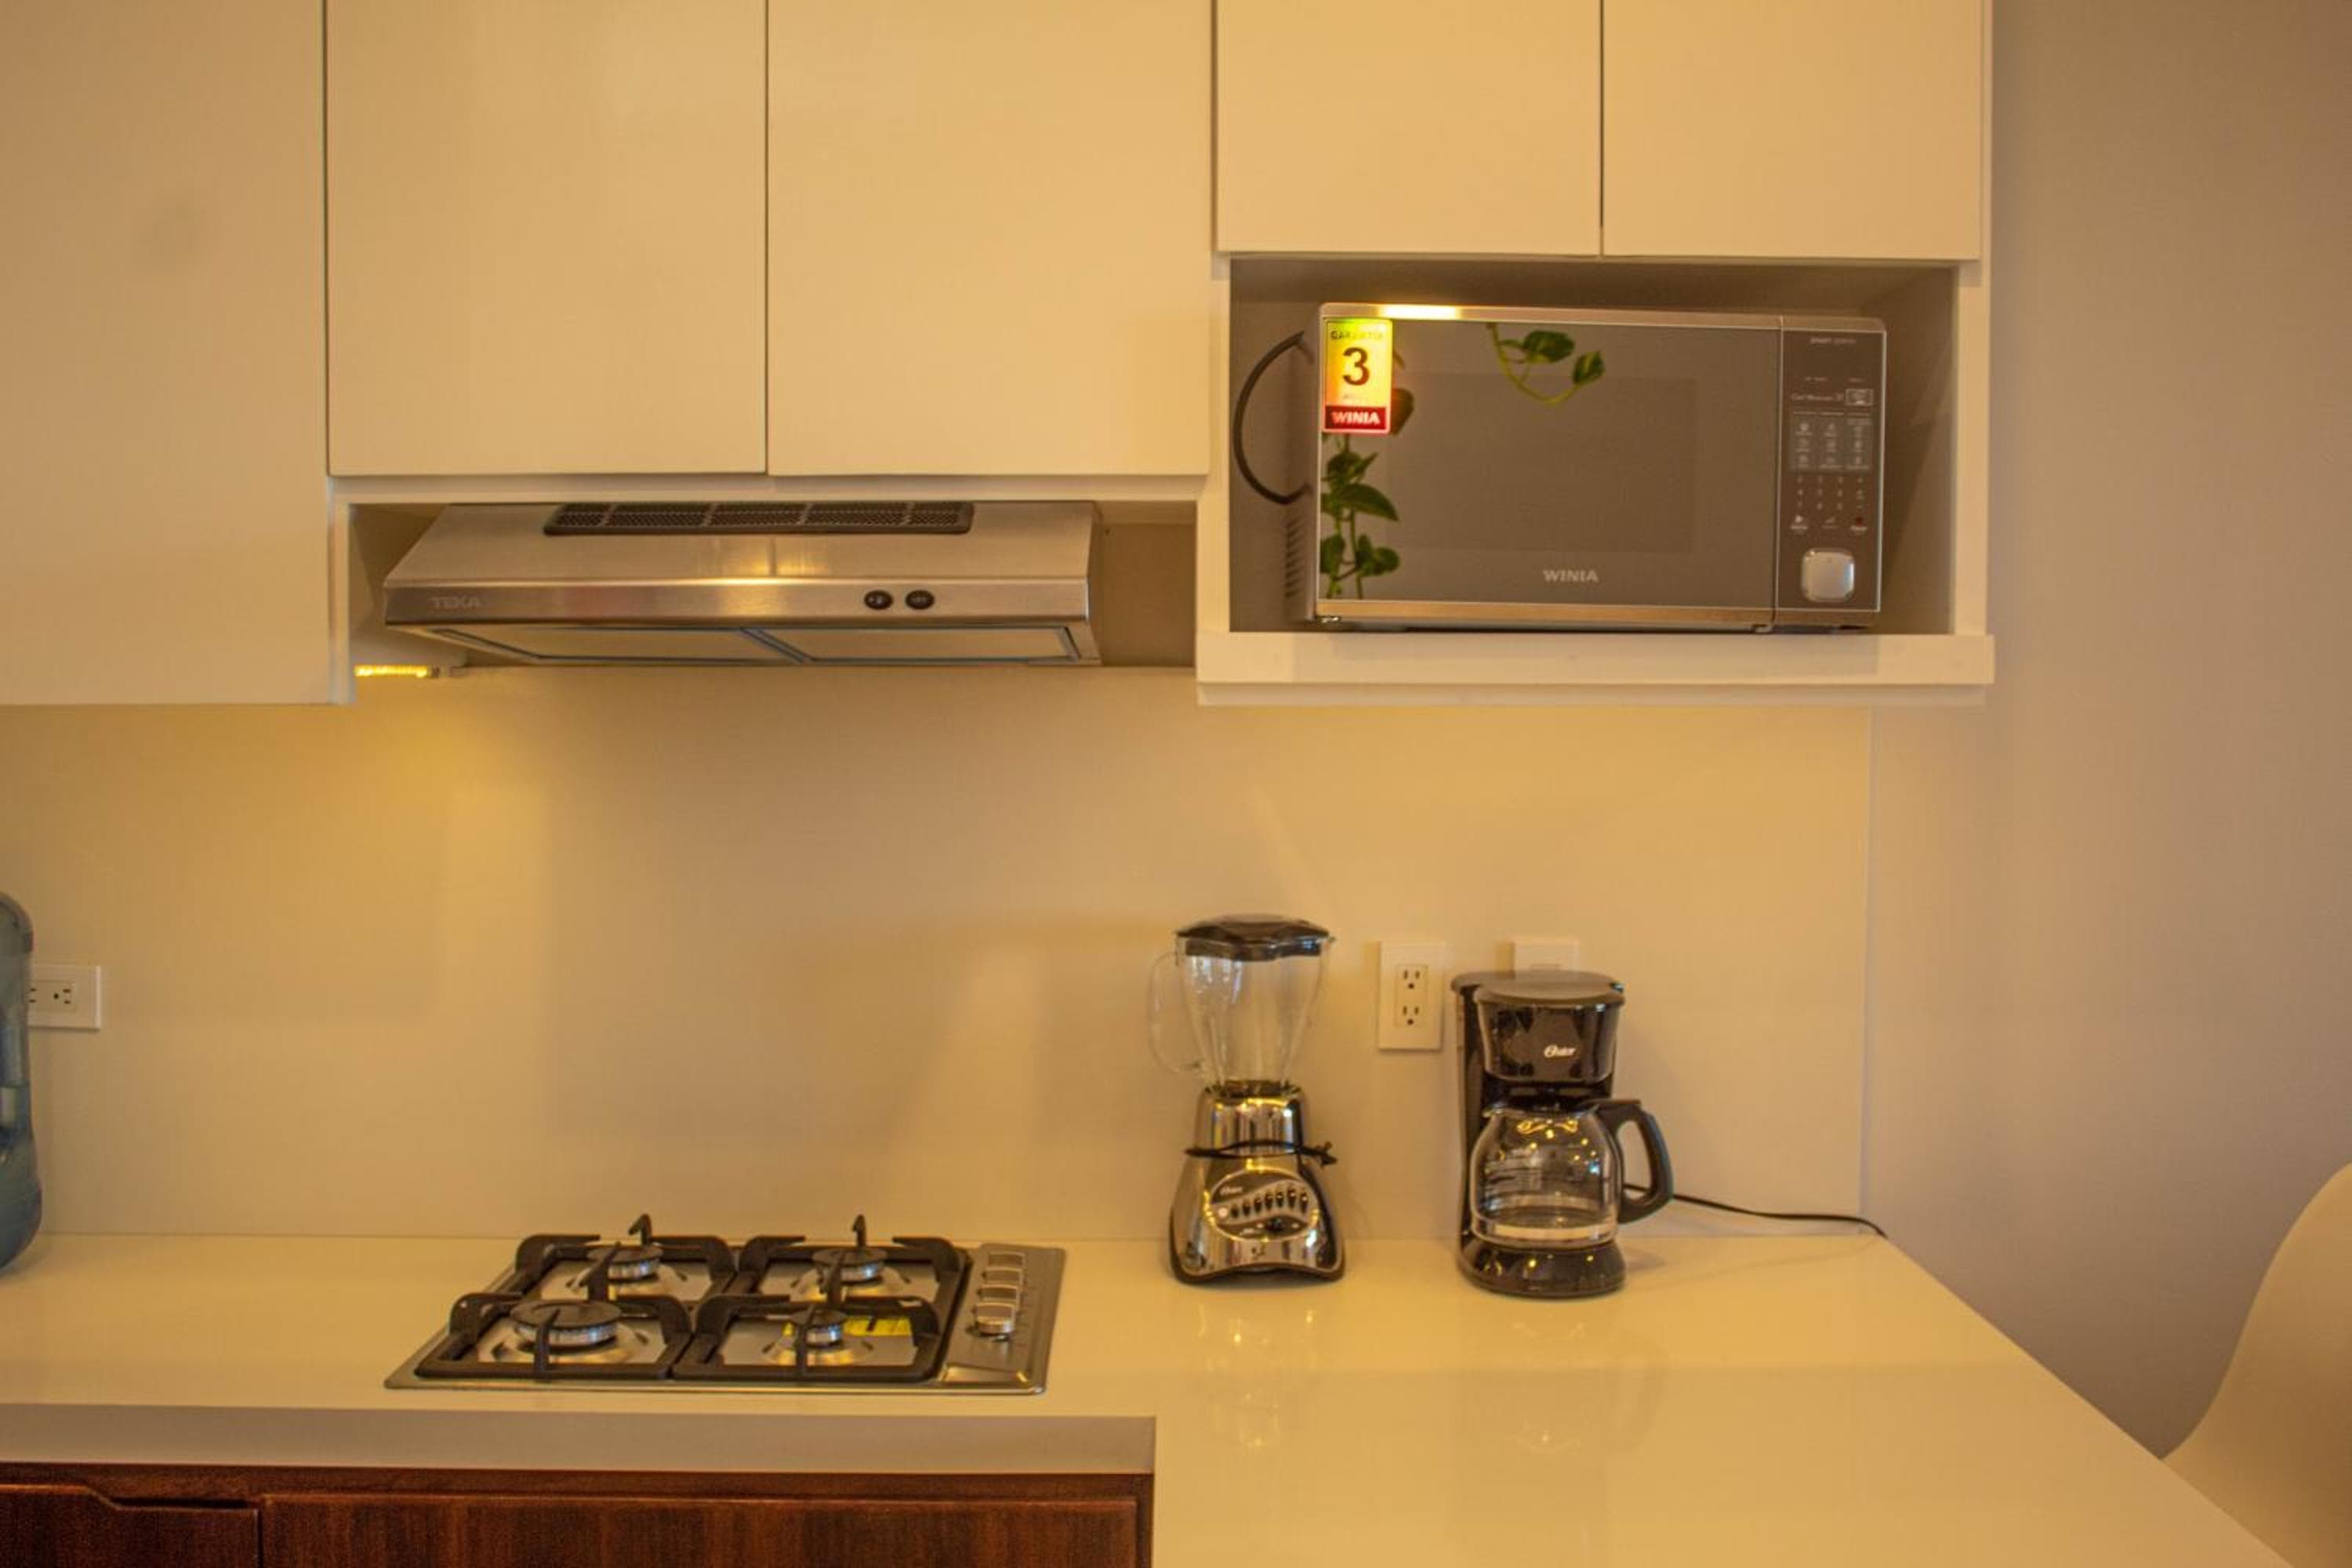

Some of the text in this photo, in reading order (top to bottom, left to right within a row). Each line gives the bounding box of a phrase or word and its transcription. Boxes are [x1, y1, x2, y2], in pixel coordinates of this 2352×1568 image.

[1342, 347, 1370, 387] 3
[1330, 411, 1381, 425] WINIA
[1542, 569, 1599, 583] WINIA
[428, 596, 481, 610] TEKA
